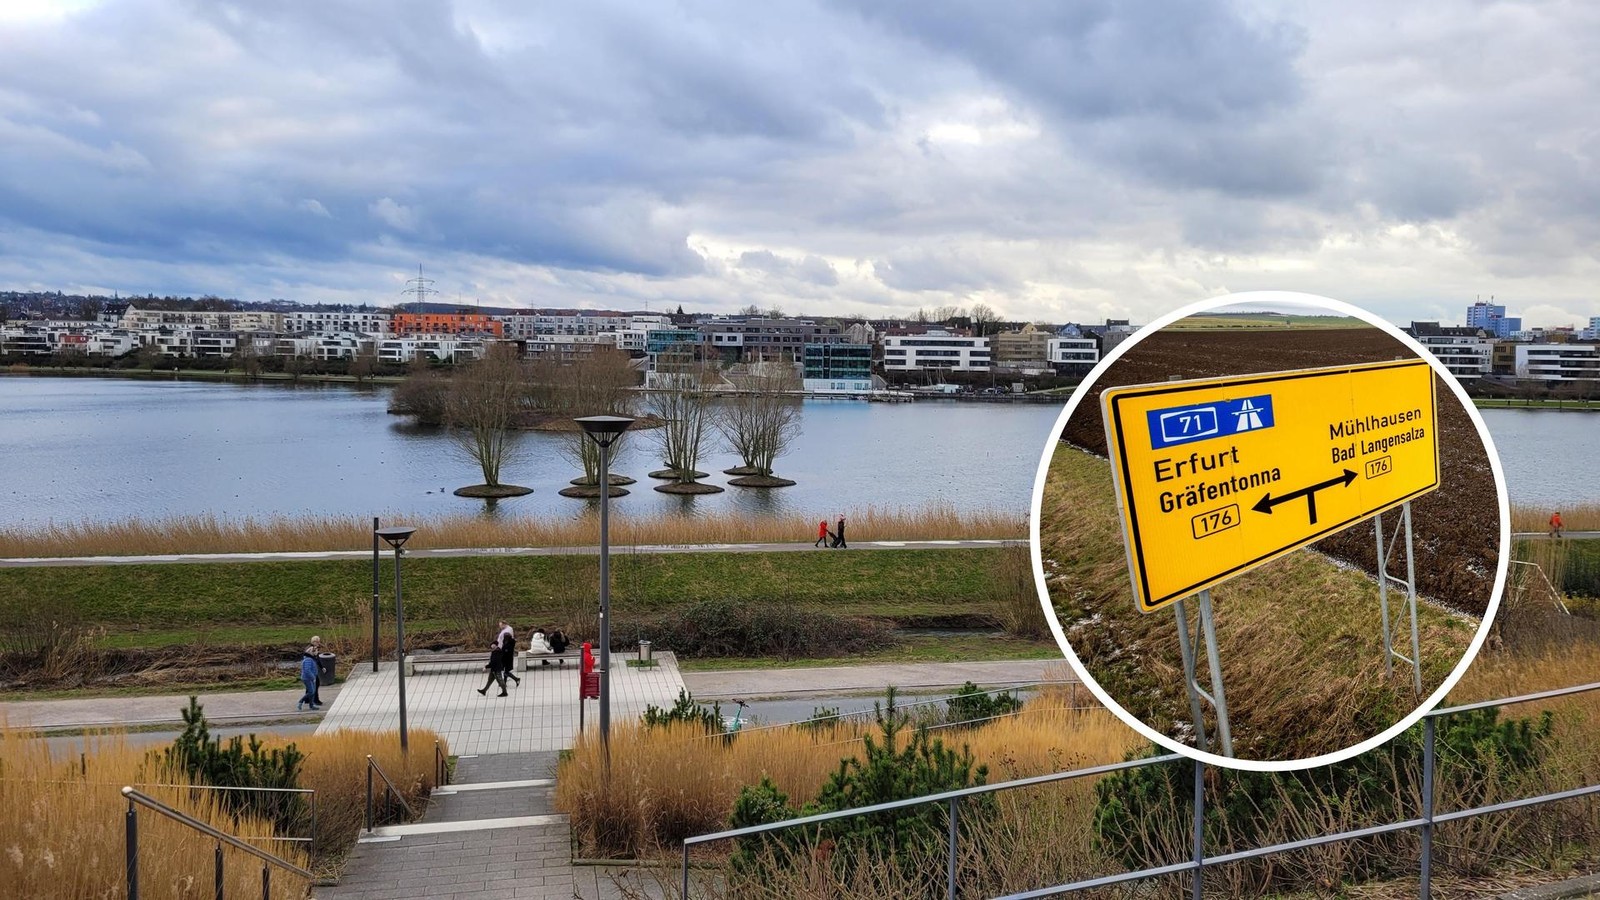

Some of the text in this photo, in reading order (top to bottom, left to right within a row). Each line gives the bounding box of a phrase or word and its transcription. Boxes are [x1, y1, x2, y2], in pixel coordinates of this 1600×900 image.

[1179, 414, 1202, 434] 71
[1329, 406, 1422, 440] Mühlhausen
[1331, 425, 1425, 464] Bad Langensalza
[1153, 446, 1240, 483] Erfurt
[1369, 459, 1388, 475] 176
[1159, 467, 1281, 513] Gräfentonna
[1200, 508, 1232, 533] 176
